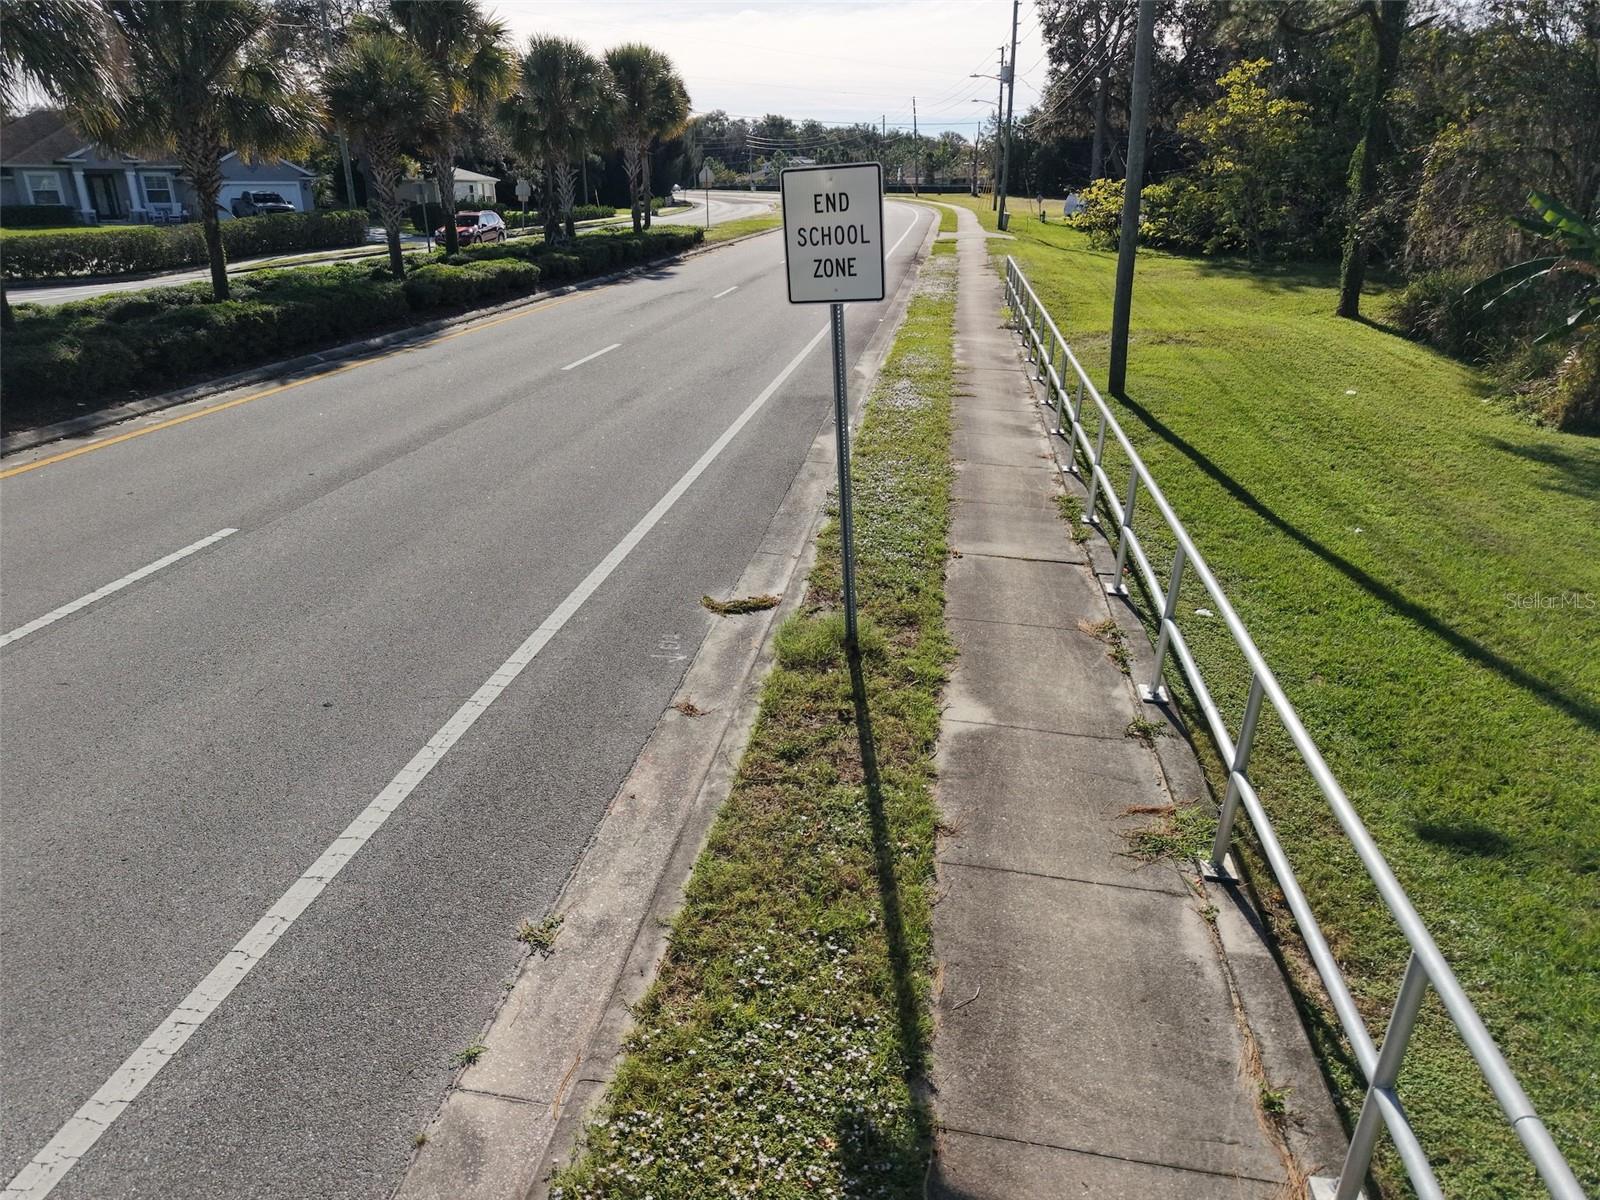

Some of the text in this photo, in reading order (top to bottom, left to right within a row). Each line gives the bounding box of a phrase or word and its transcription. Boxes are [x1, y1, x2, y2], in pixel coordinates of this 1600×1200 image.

[813, 192, 850, 214] END
[797, 224, 871, 247] SCHOOL
[813, 257, 858, 279] ZONE
